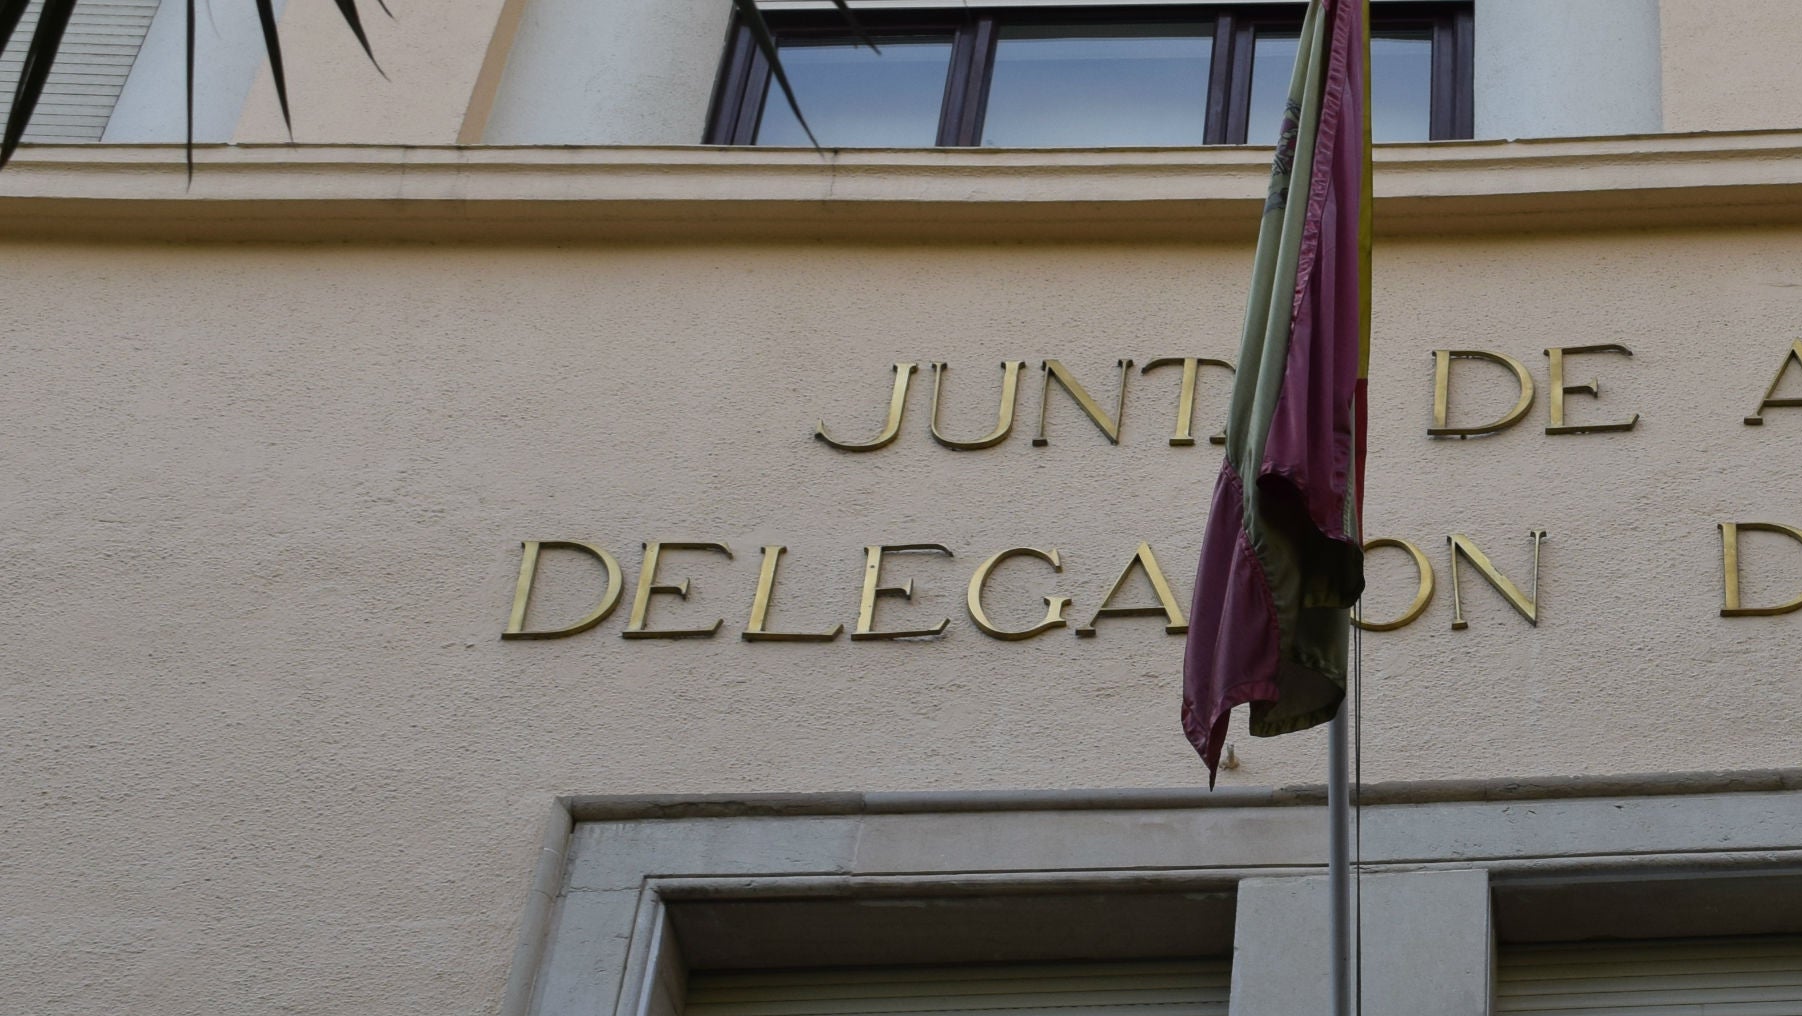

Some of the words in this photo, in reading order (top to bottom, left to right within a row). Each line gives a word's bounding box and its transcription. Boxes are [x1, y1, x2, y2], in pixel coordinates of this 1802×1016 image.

[814, 356, 1237, 453] JUNT
[1425, 342, 1640, 441] DE
[500, 529, 1548, 643] DELEGAON
